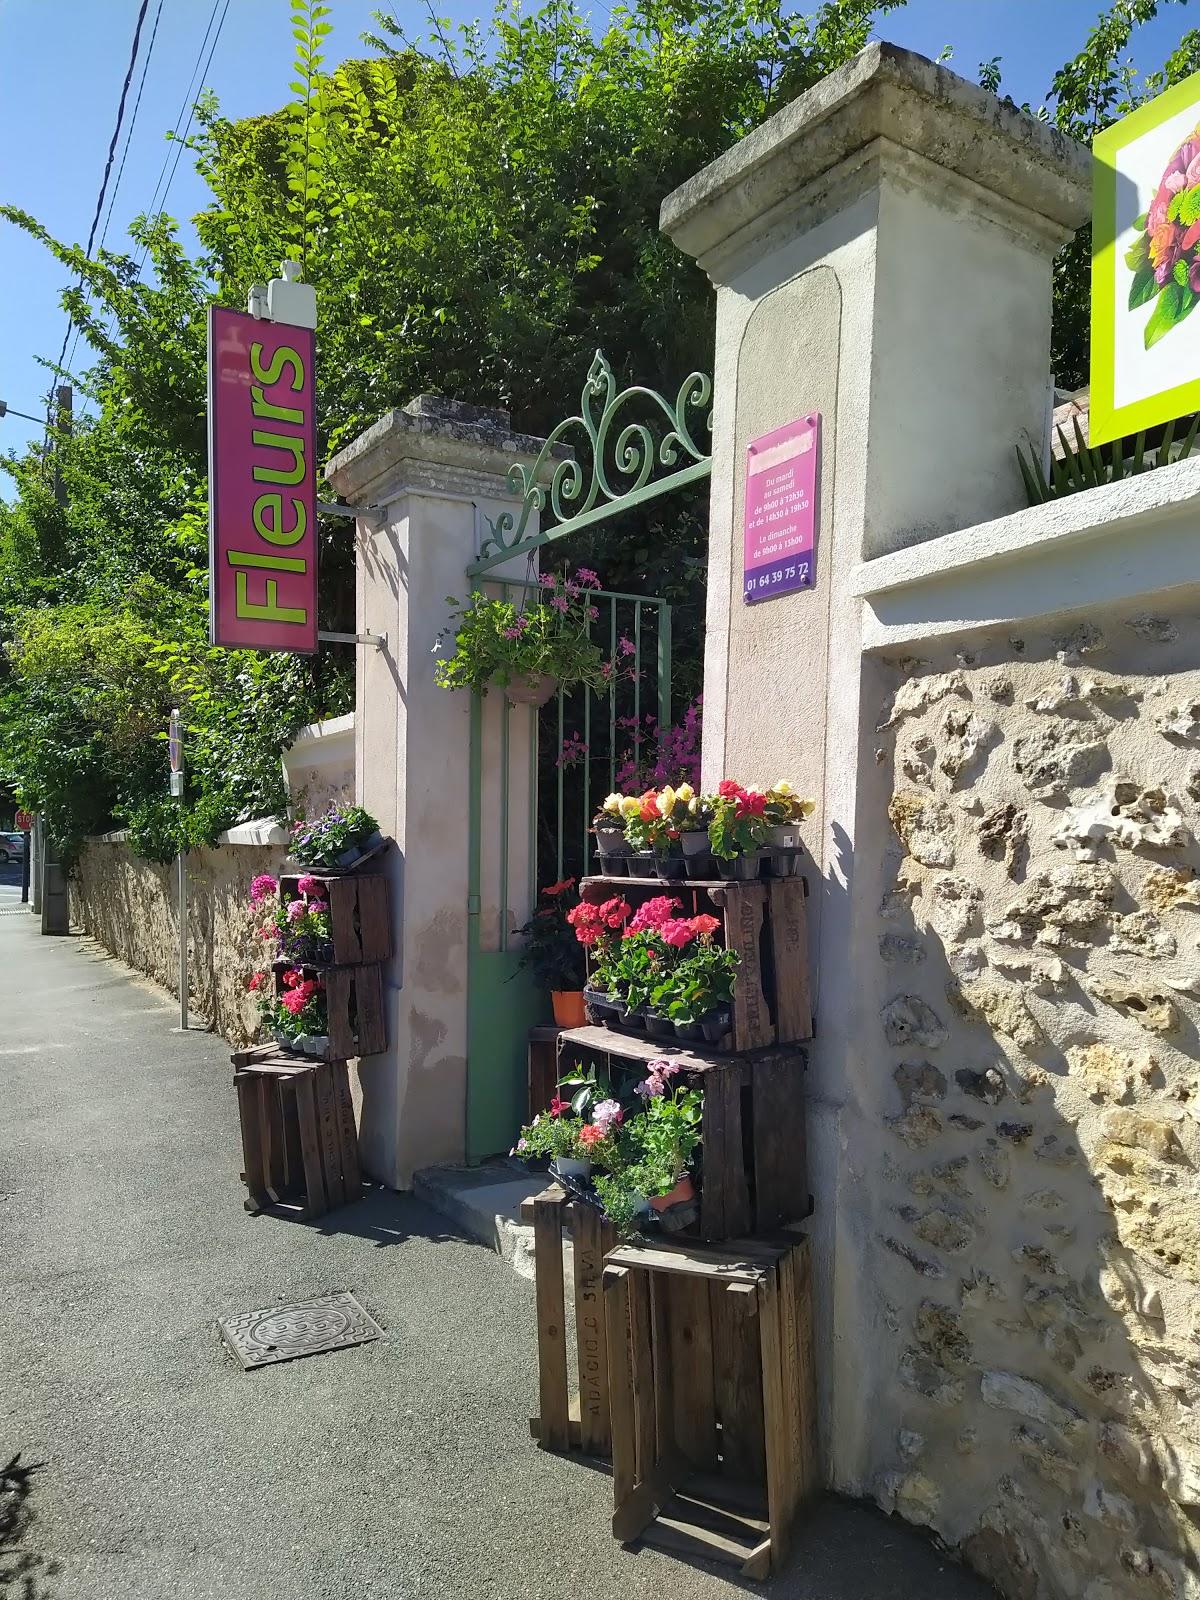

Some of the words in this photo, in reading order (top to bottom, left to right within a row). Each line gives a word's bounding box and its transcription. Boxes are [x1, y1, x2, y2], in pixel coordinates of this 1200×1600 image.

[226, 341, 308, 626] Fleurs
[776, 469, 793, 483] mardi
[764, 490, 771, 499] au
[773, 479, 795, 495] samedi
[755, 506, 762, 515] de
[764, 501, 778, 511] 9h00
[780, 497, 783, 505] à
[784, 490, 804, 503] 12h30
[749, 521, 754, 529] et
[757, 518, 764, 526] de
[766, 510, 783, 523] 14h30
[791, 500, 809, 513] 19h30
[768, 525, 797, 541] dimanche
[754, 550, 761, 558] de
[763, 544, 777, 555] 9h00
[748, 579, 756, 590] 01
[760, 574, 769, 586] 64
[772, 571, 782, 583] 39
[785, 567, 795, 579] 75
[798, 563, 808, 575] 72
